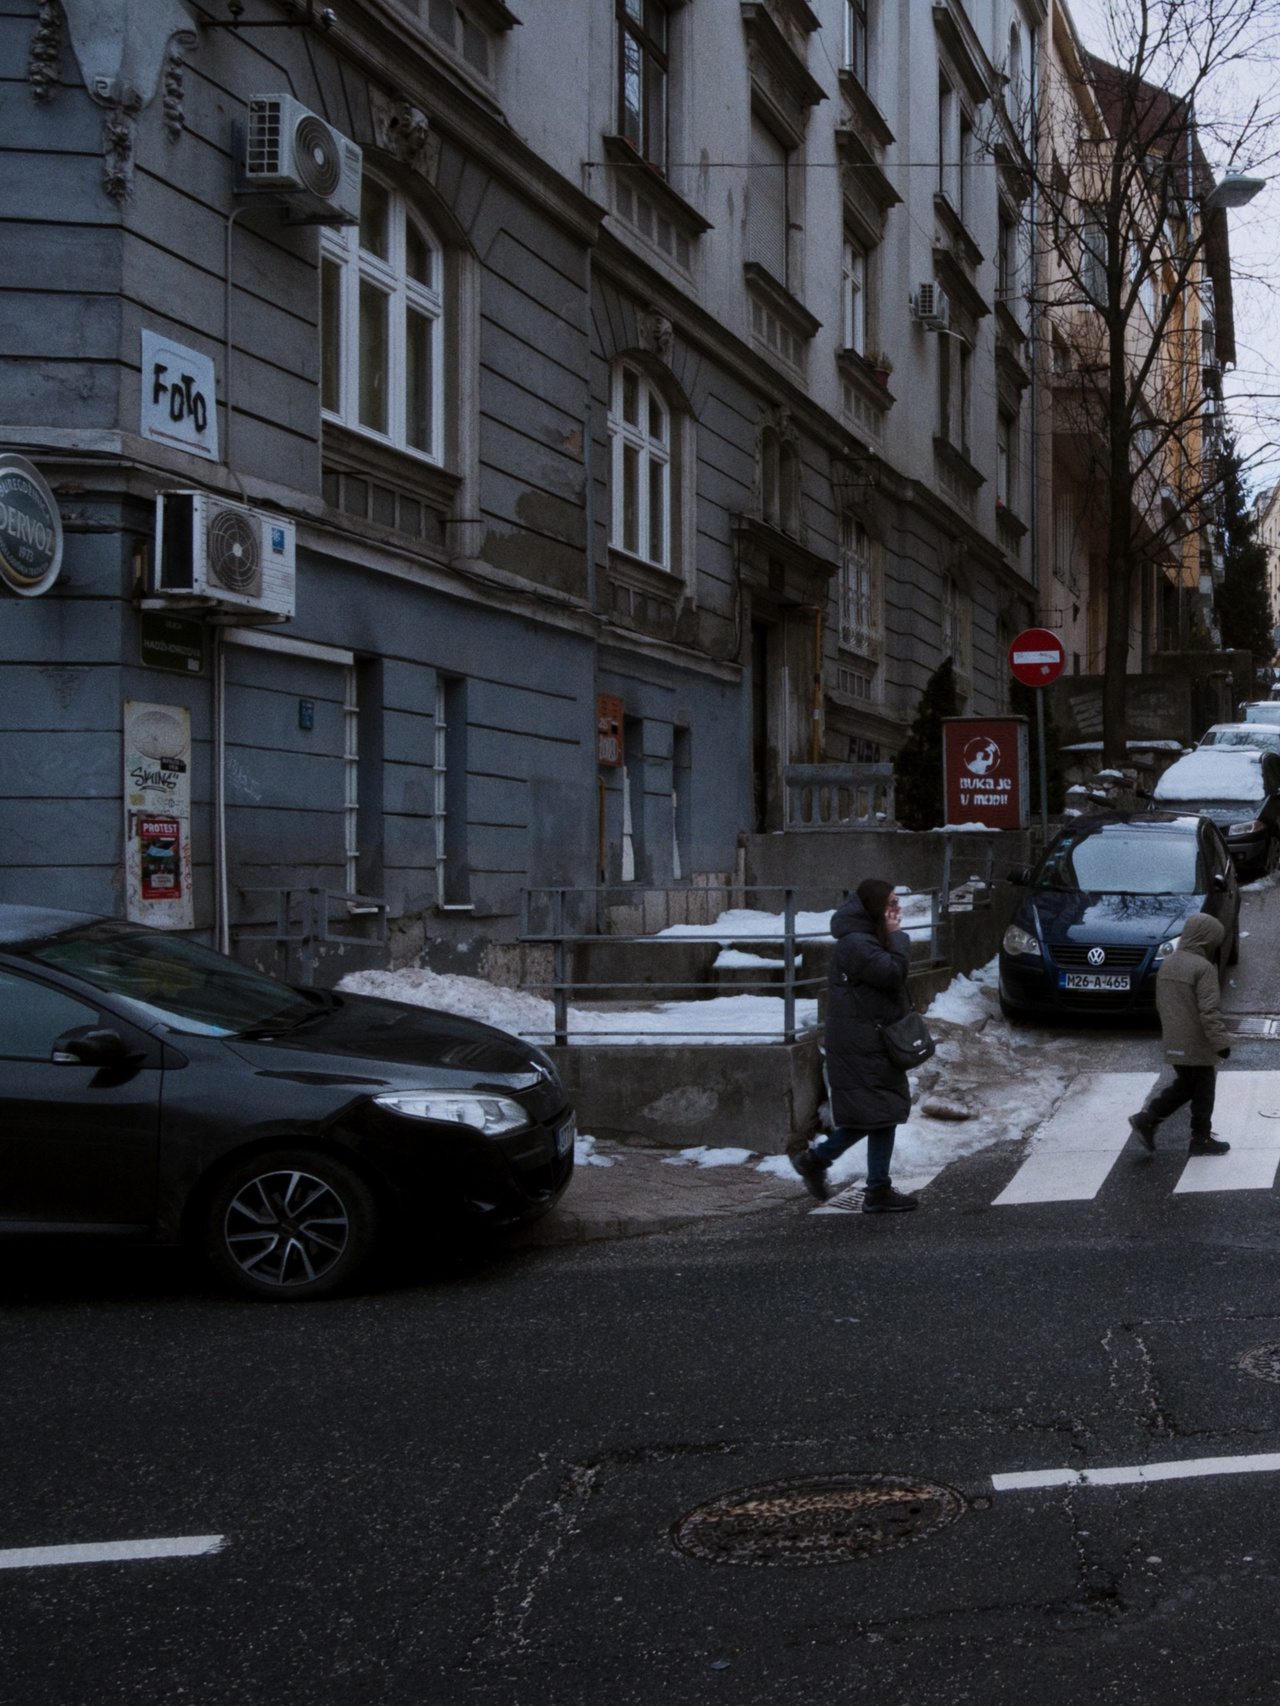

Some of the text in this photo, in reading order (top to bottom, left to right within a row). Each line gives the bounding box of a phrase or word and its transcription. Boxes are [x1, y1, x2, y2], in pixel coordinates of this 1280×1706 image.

[153, 362, 208, 433] FOTO
[142, 822, 178, 834] PROTEST
[1066, 974, 1129, 989] M26-A-465
